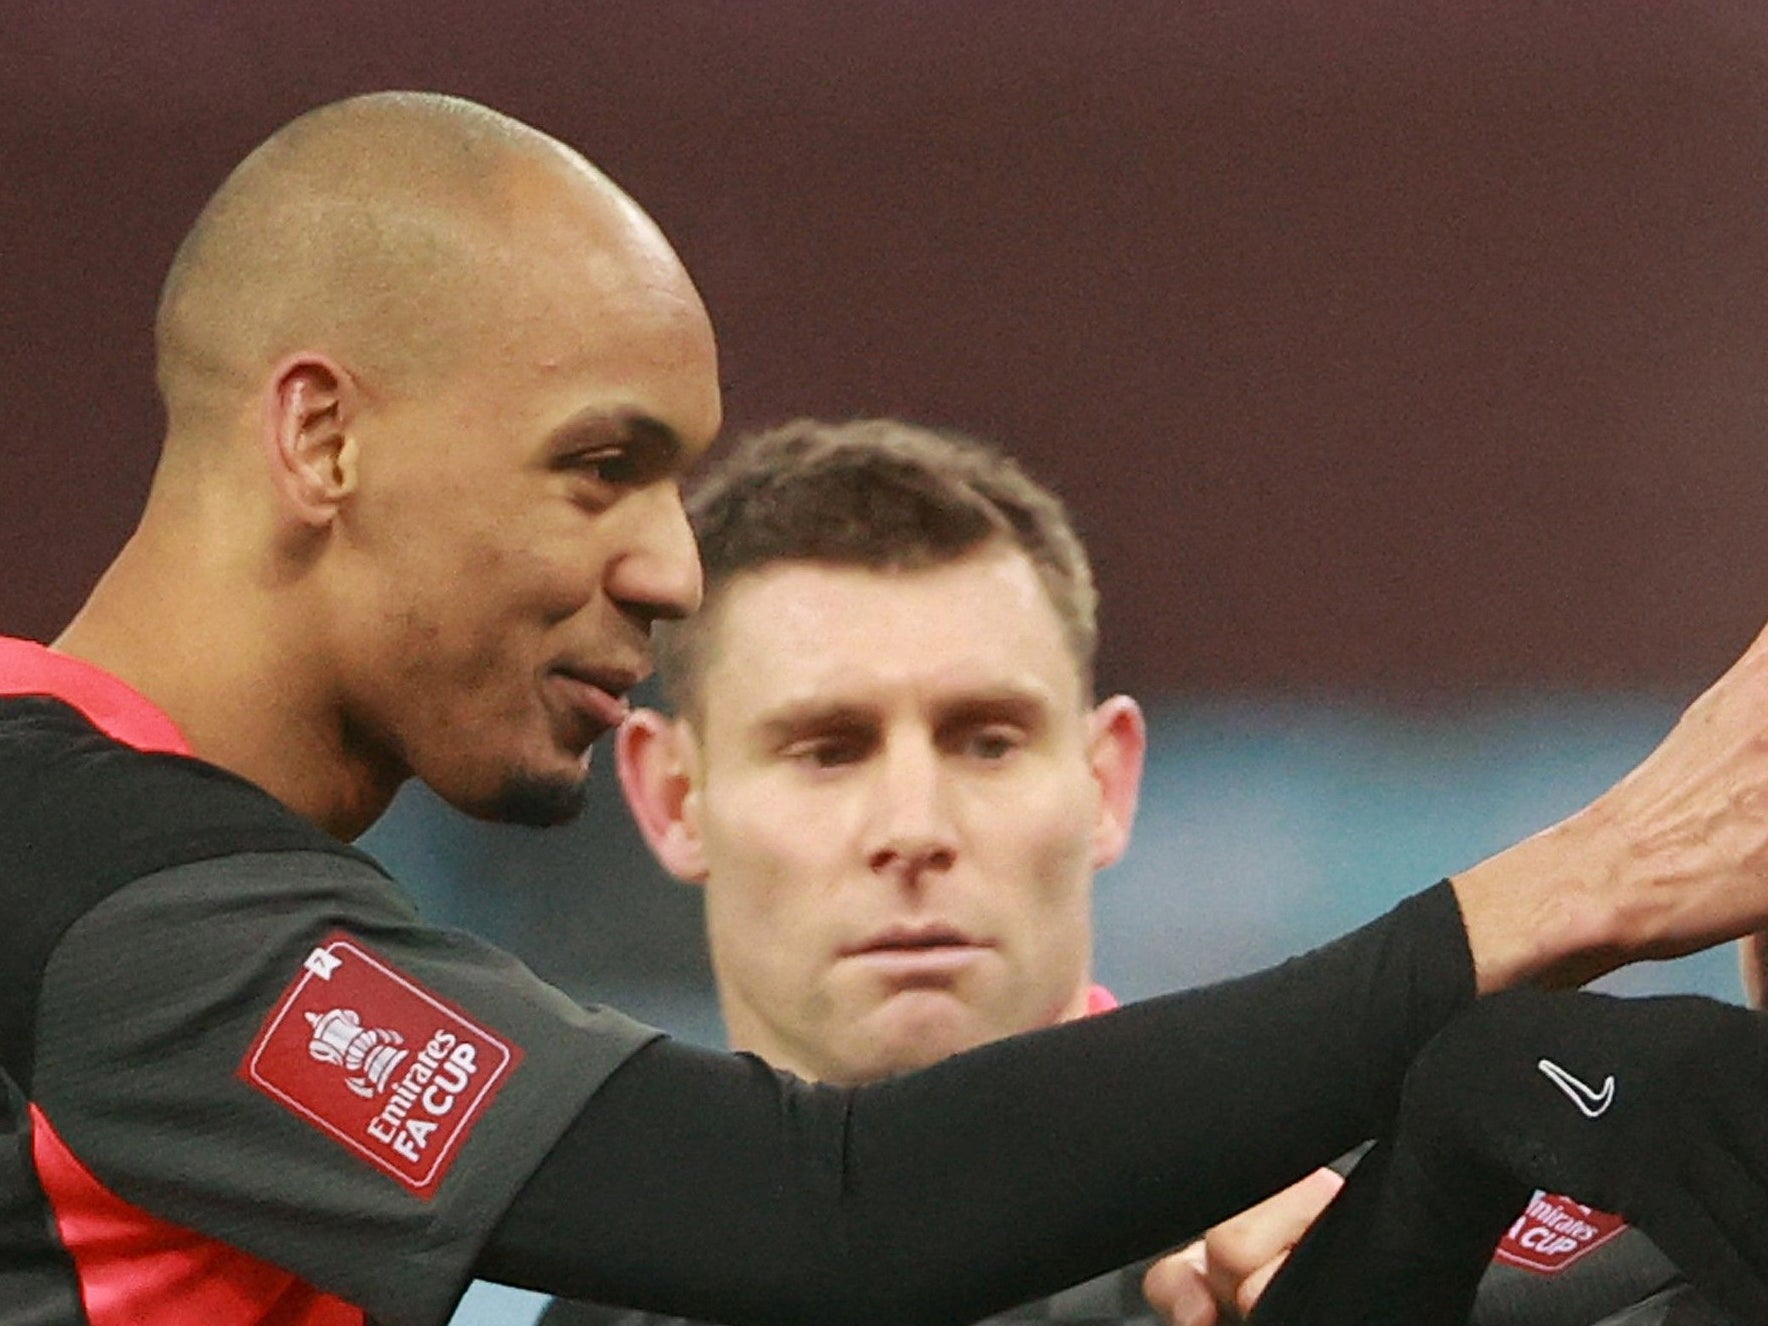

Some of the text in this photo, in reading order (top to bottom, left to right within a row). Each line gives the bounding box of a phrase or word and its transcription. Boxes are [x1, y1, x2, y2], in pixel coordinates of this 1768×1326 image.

[368, 1029, 456, 1143] Emirates
[392, 1042, 477, 1163] FA CUP
[1520, 1226, 1578, 1256] CUP
